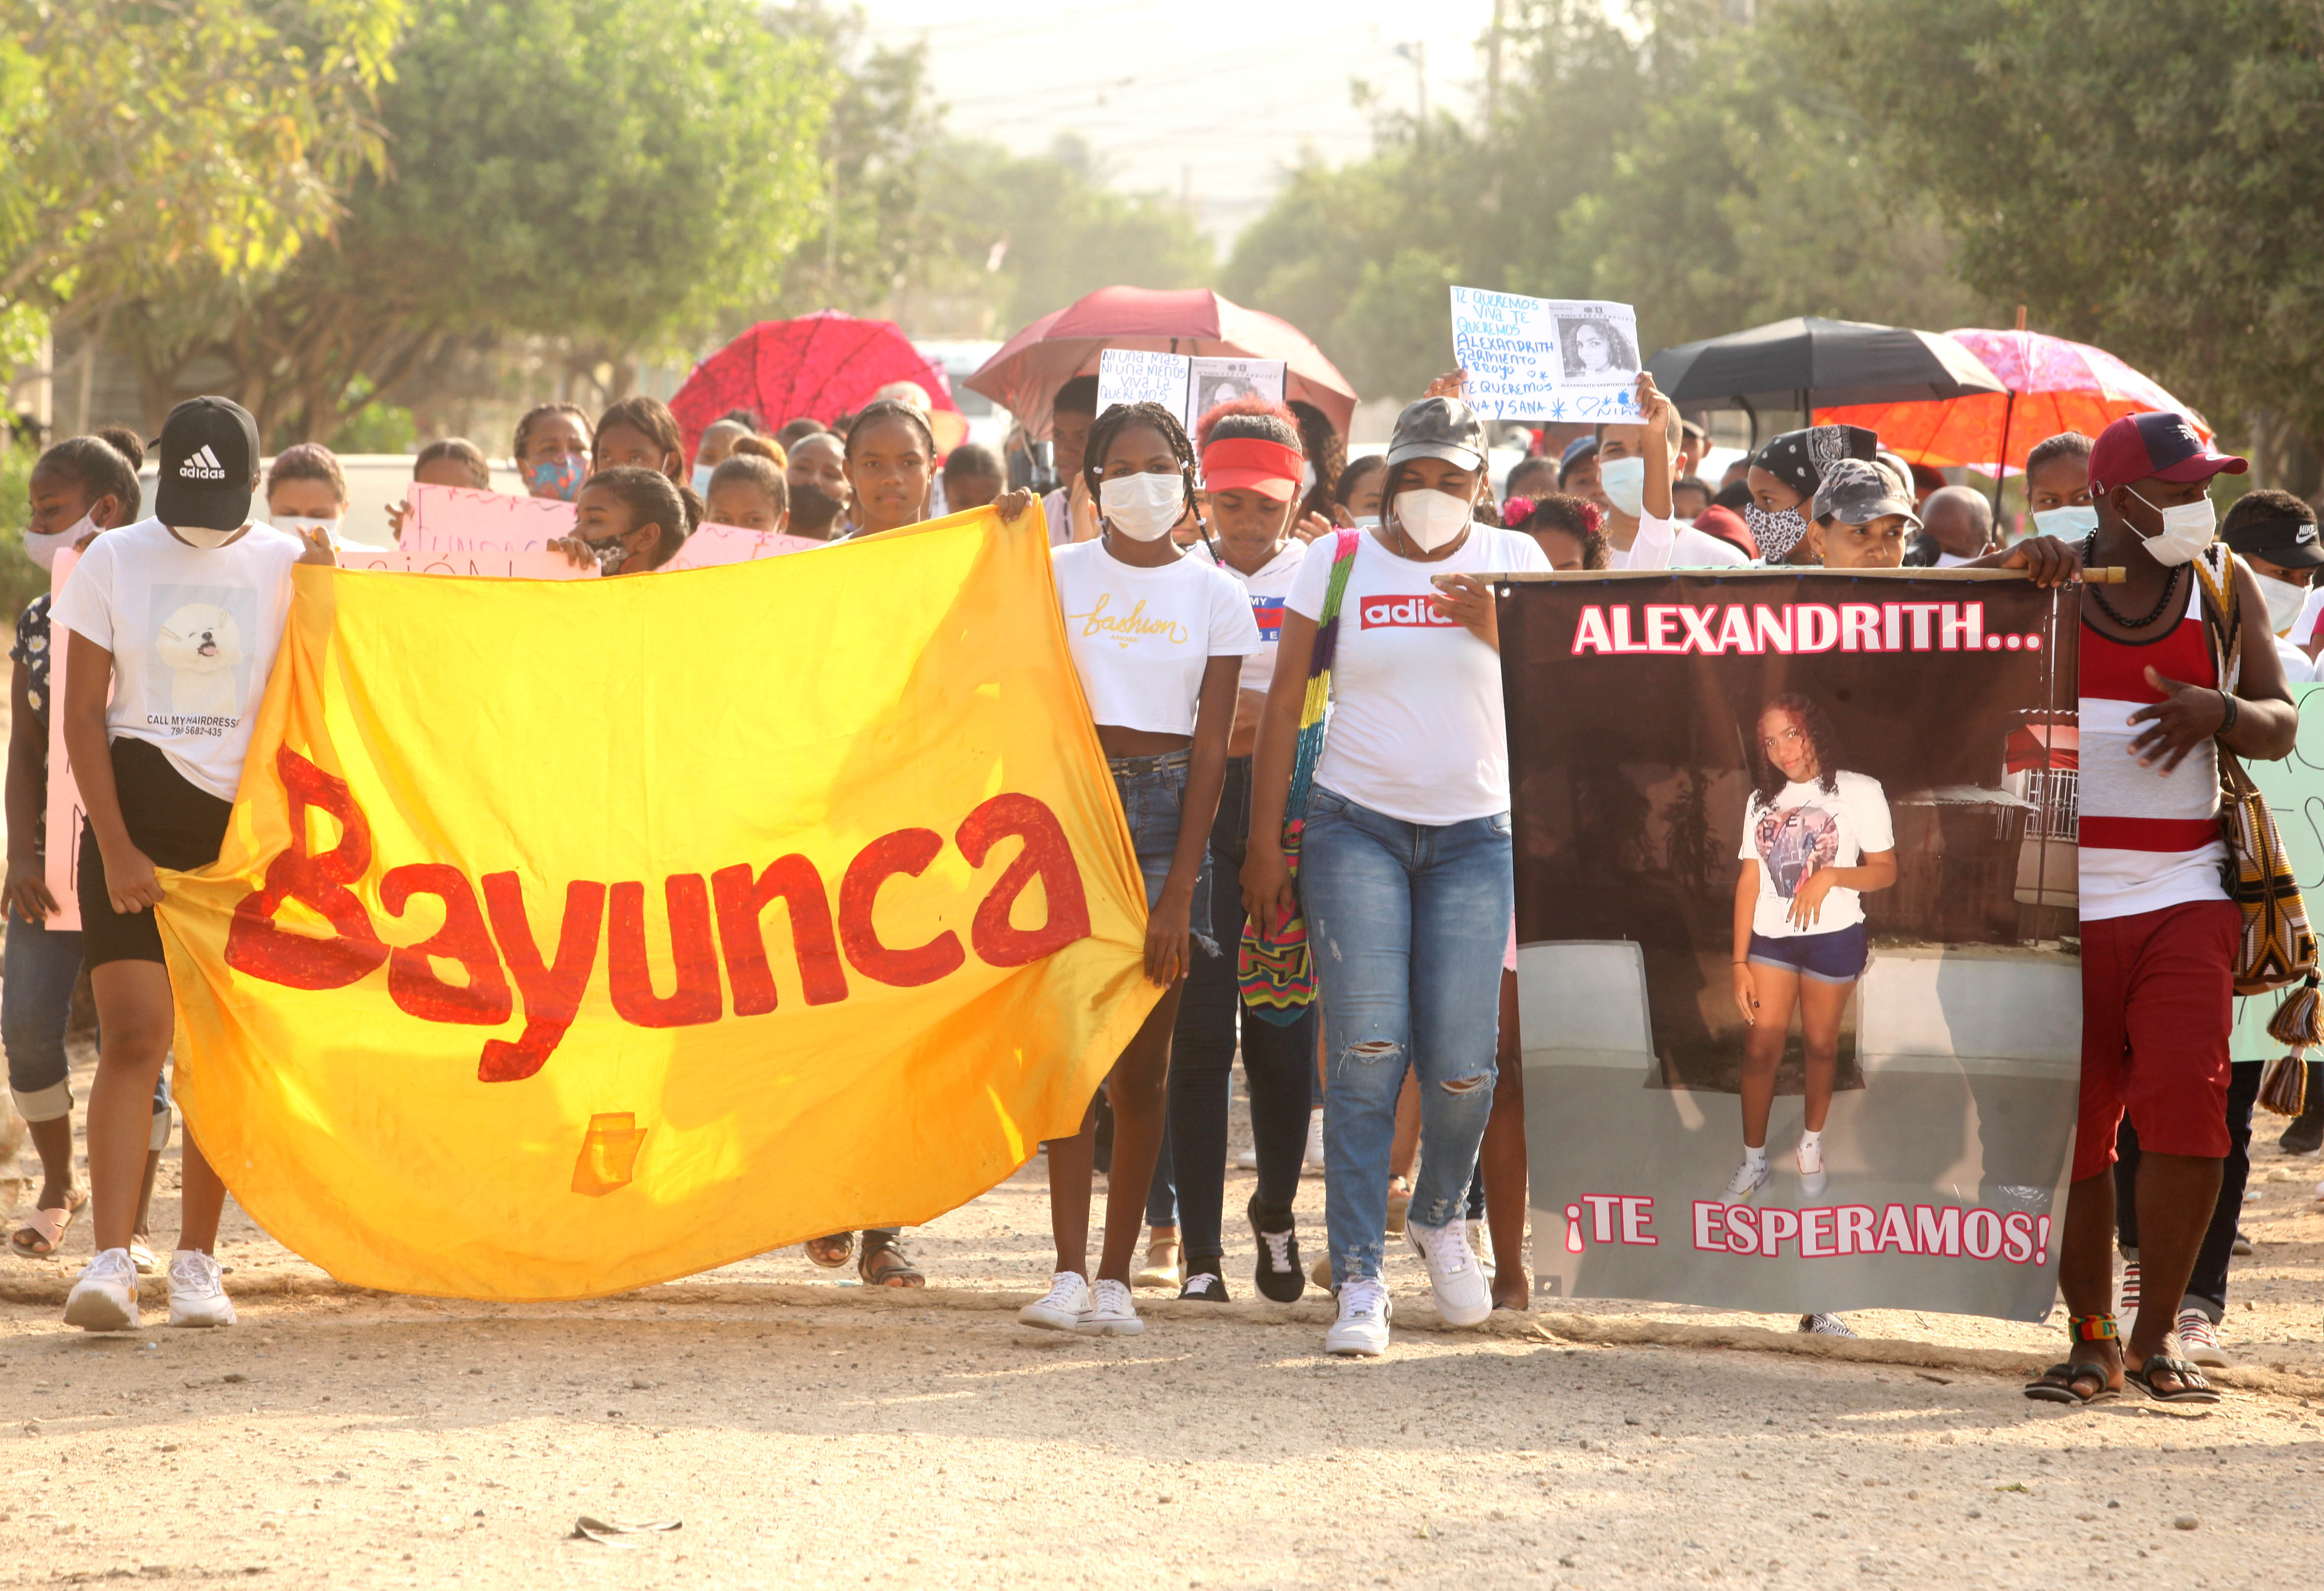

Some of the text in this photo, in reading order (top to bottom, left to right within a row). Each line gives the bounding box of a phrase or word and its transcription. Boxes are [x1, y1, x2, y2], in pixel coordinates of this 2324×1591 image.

[1452, 287, 1539, 310] TE QUEREMOS
[1510, 310, 1530, 324] TE
[1456, 317, 1520, 336] QUEREMOS
[1102, 350, 1115, 360] NI
[1101, 361, 1112, 374] NI
[1460, 381, 1552, 395] TE QUEREMOS
[1495, 400, 1504, 419] Y
[1508, 400, 1547, 414] SANA
[180, 467, 225, 479] adidas
[2299, 524, 2314, 535] NIKE
[1068, 593, 1188, 644] fashion
[1572, 602, 2042, 655] ALEXANDRITH...
[1110, 634, 1138, 642] AMORE
[147, 715, 169, 725] CALL
[171, 716, 186, 725] MY
[224, 739, 1092, 1083] Bayunca
[1564, 1193, 2051, 1267] ¡TE ESPERAMOS!
